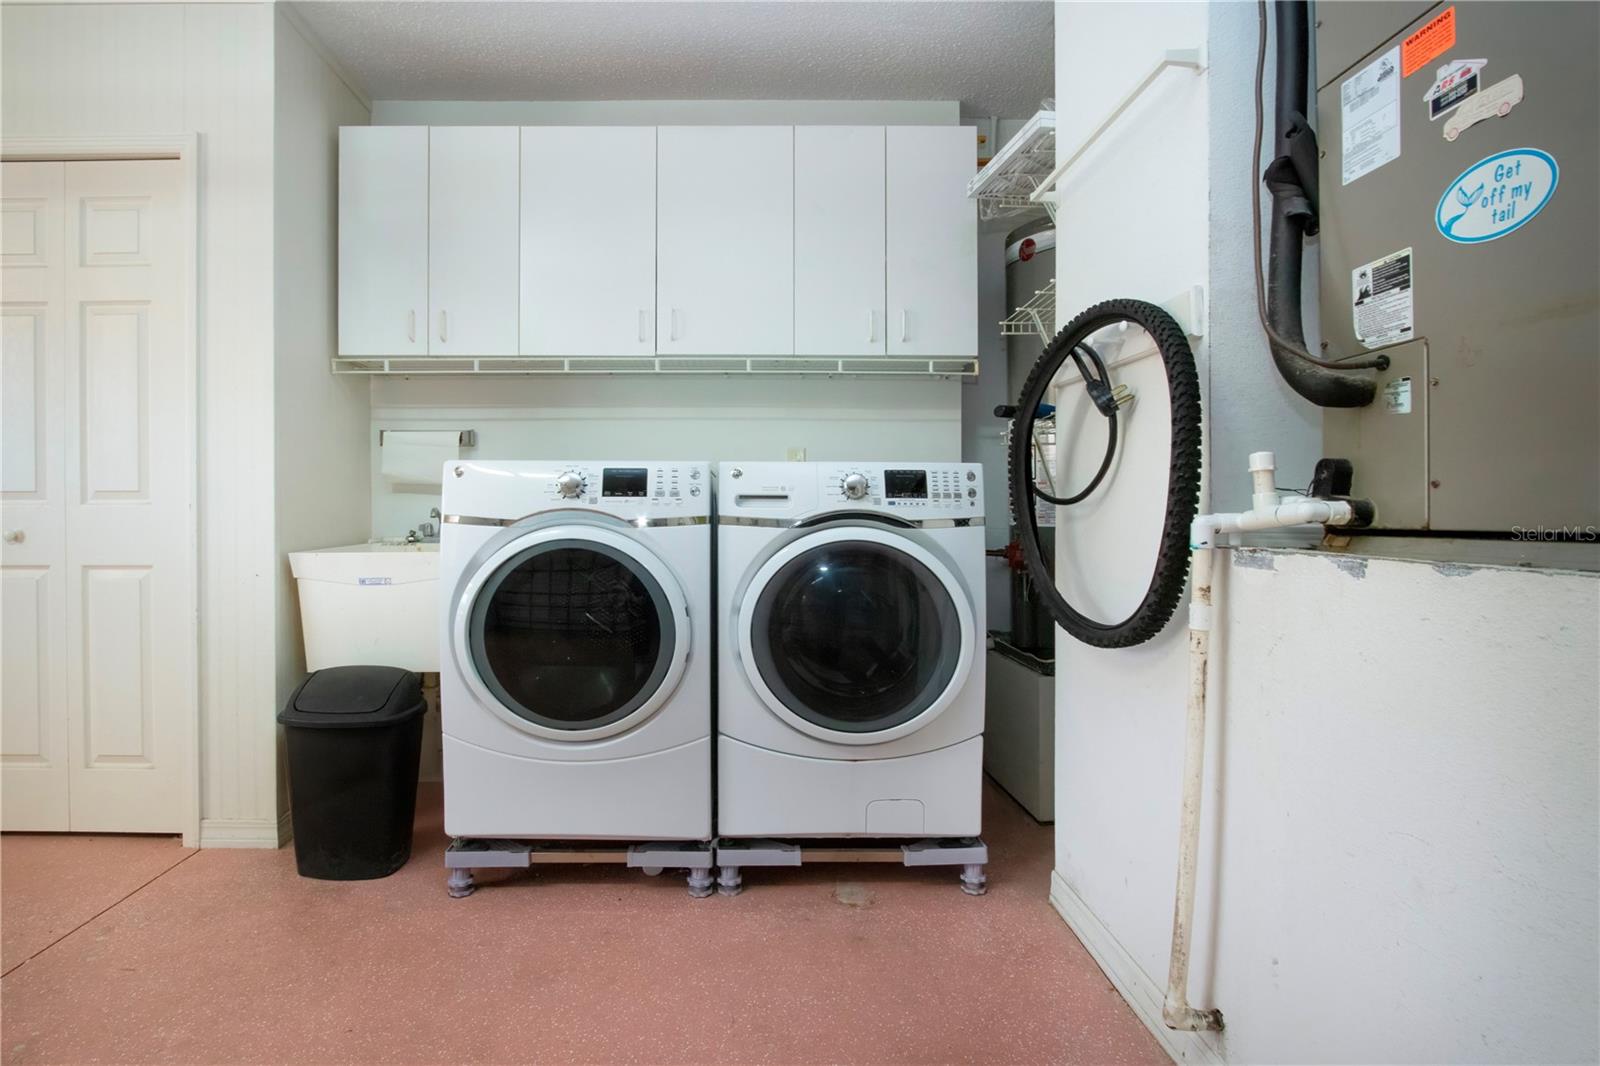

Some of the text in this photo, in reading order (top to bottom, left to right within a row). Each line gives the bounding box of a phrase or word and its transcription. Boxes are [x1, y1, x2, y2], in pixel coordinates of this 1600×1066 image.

[1406, 11, 1451, 46] WARNING
[1494, 160, 1521, 183] Get
[1481, 181, 1532, 208] off my
[1491, 200, 1516, 224] tail
